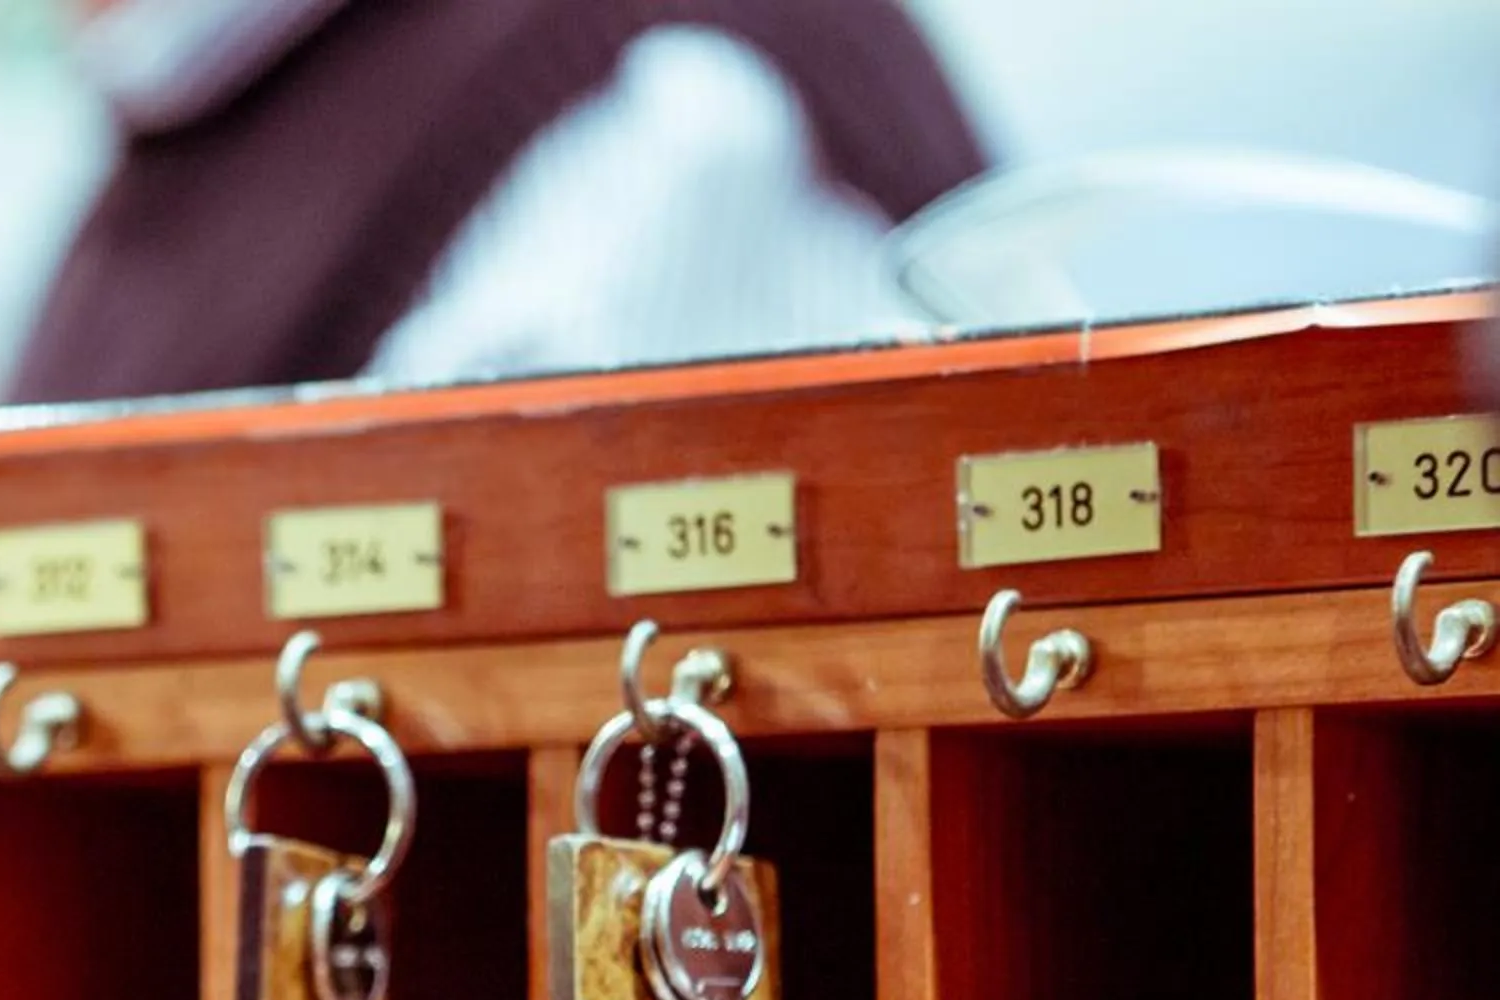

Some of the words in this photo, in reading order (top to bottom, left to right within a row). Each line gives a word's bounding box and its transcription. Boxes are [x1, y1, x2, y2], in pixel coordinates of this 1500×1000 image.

[1413, 447, 1500, 501] 320
[1021, 481, 1094, 532] 318
[666, 510, 736, 562] 316
